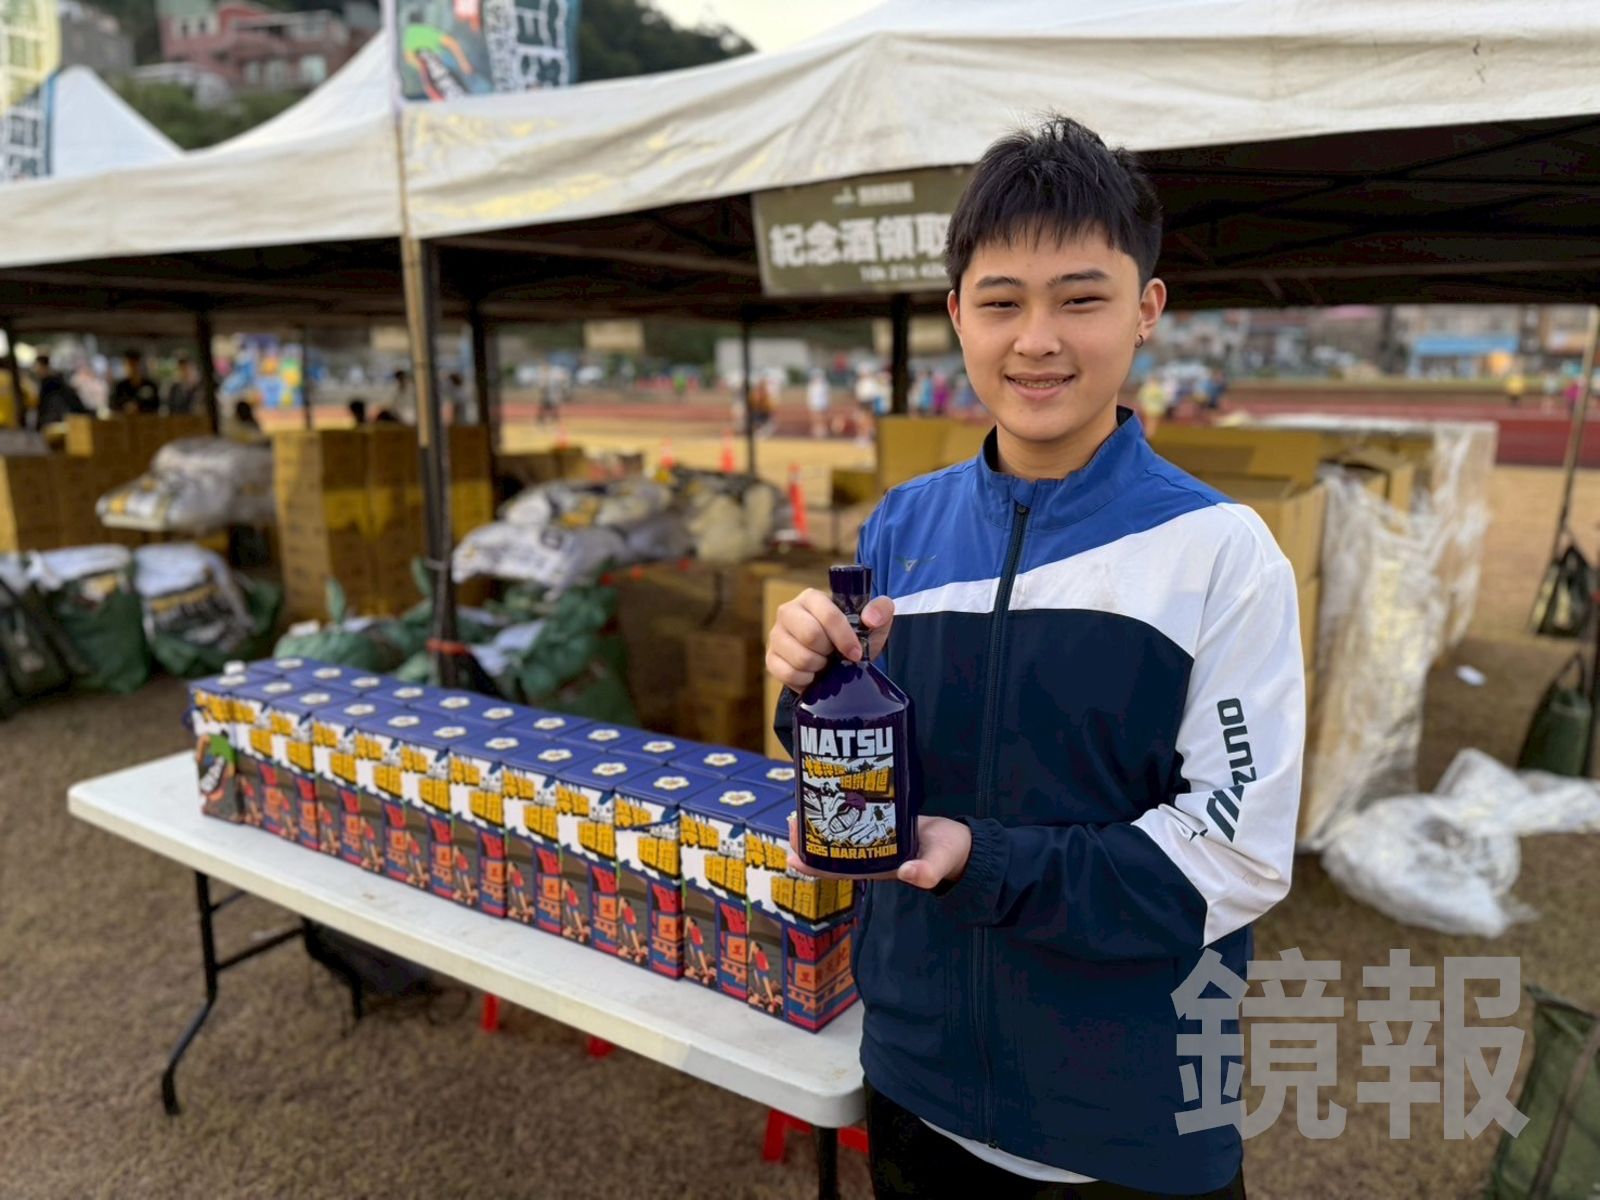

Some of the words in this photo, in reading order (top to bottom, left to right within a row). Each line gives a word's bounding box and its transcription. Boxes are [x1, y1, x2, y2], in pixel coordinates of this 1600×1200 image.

[800, 725, 894, 757] MATSU
[1206, 697, 1257, 843] MZUNO
[830, 844, 898, 859] MARATHON
